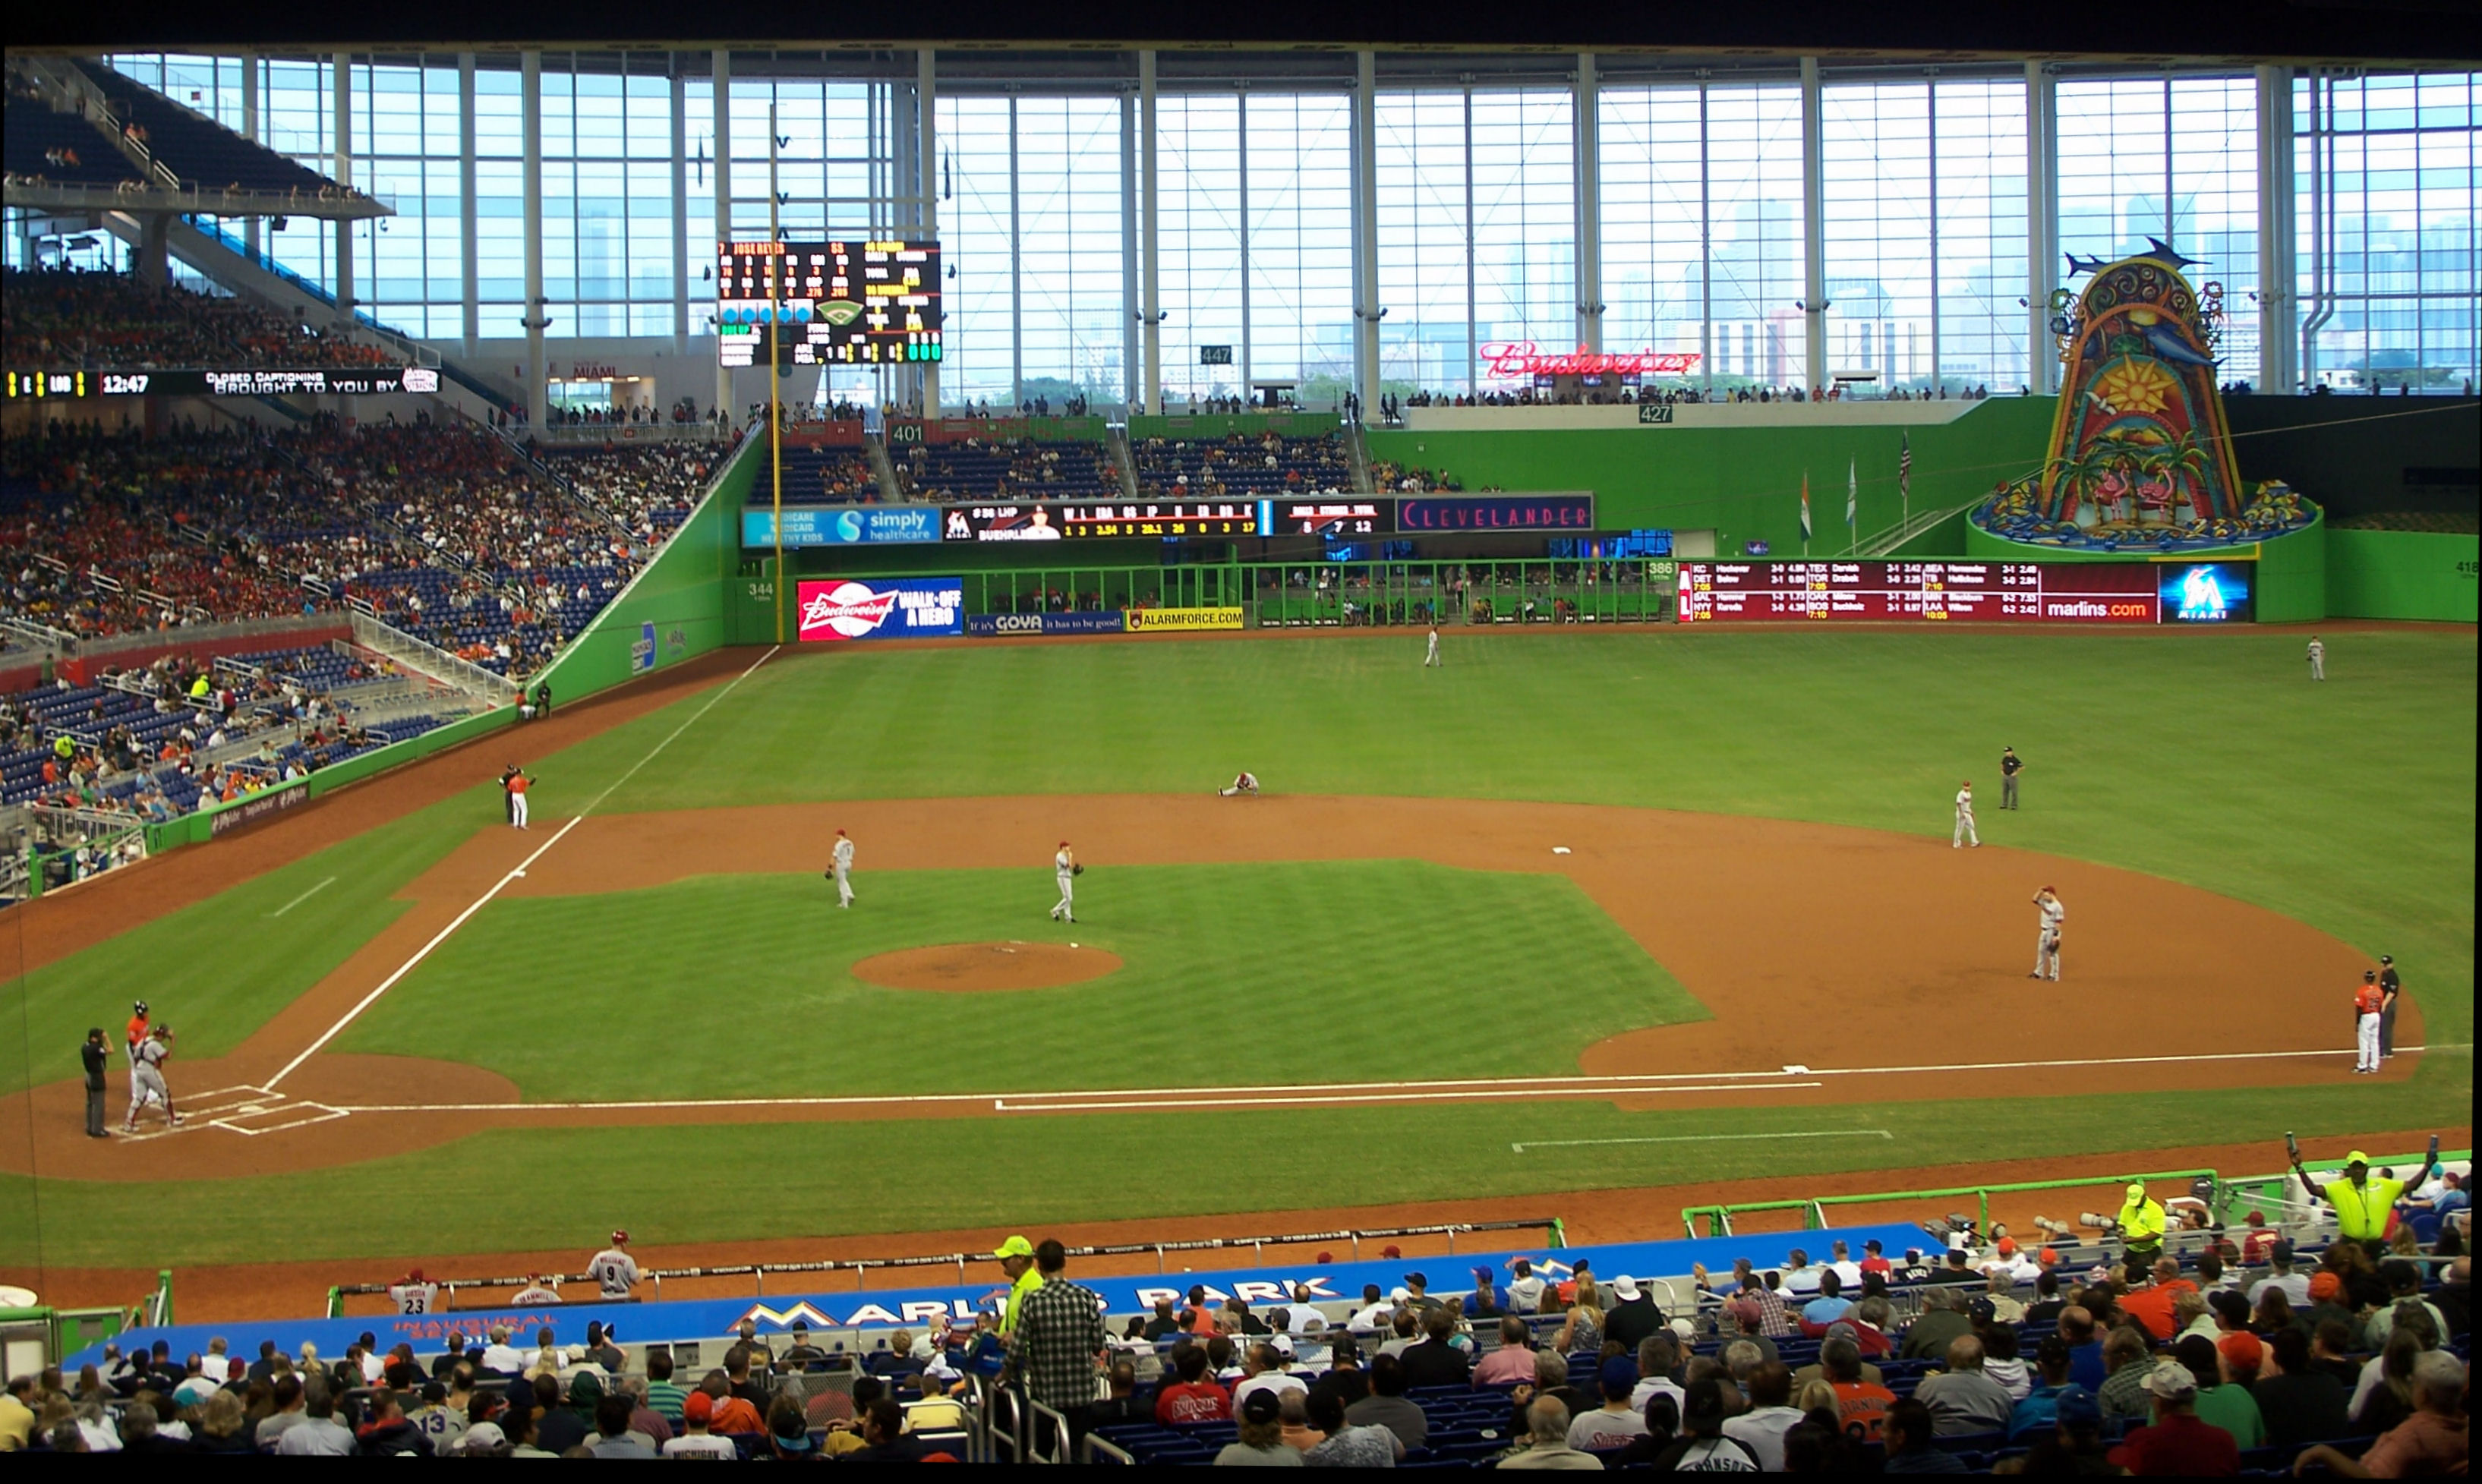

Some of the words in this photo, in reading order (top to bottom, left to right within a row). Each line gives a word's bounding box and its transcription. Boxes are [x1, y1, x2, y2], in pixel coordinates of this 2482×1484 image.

[733, 242, 755, 255] JOSE
[1202, 348, 1230, 363] 447
[1481, 340, 1702, 380] Budweiser
[206, 372, 251, 383] CLOSED
[255, 372, 324, 383] CAPTIONING
[573, 366, 617, 378] MIAMI
[102, 375, 149, 393] 12:47
[214, 381, 297, 394] BROUGHT
[303, 382, 326, 392] TO
[333, 380, 368, 392] YOU
[376, 380, 398, 392] BY
[1641, 406, 1670, 423] 427
[893, 424, 922, 442] 401
[870, 510, 926, 530] simply
[1404, 501, 1586, 527] CLEVELANDER
[1334, 520, 1345, 533] 7
[1355, 521, 1372, 532] 12
[802, 533, 823, 543] KIDS
[870, 529, 930, 540] healthcare
[1649, 562, 1673, 575] 386
[1809, 564, 1828, 573] TEX
[2455, 560, 2479, 573] 418
[1692, 575, 1712, 583] DET
[1809, 574, 1828, 583] TOR
[749, 582, 774, 596] 344
[1693, 583, 1711, 591] 7:05
[1809, 582, 1827, 591] 7:05
[1925, 582, 1944, 591] 7:10
[803, 600, 894, 619] Budweiser
[1693, 603, 1712, 612] NYY
[2048, 600, 2146, 617] marlins.com
[906, 609, 918, 627] A
[918, 607, 954, 626] HERO
[1143, 612, 1243, 625] ALARMFORCE.COM
[1693, 611, 1711, 619] 7:05
[1809, 610, 1827, 619] 7:10
[1925, 610, 1948, 620] 10:05
[2178, 610, 2228, 619] MIAMI
[970, 621, 978, 631] If
[981, 622, 994, 631] it's
[995, 615, 1042, 631] GOYA
[1046, 619, 1054, 629] it
[1055, 619, 1070, 629] has
[1072, 619, 1082, 629] to
[1083, 618, 1094, 628] be
[1096, 617, 1121, 630] good!
[607, 1265, 615, 1281] 9
[1136, 1277, 1344, 1310] PARK
[405, 1299, 424, 1315] 23
[393, 1314, 560, 1331] INAUGURAL
[420, 1414, 446, 1434] 13
[673, 1449, 720, 1460] MICHIGAN
